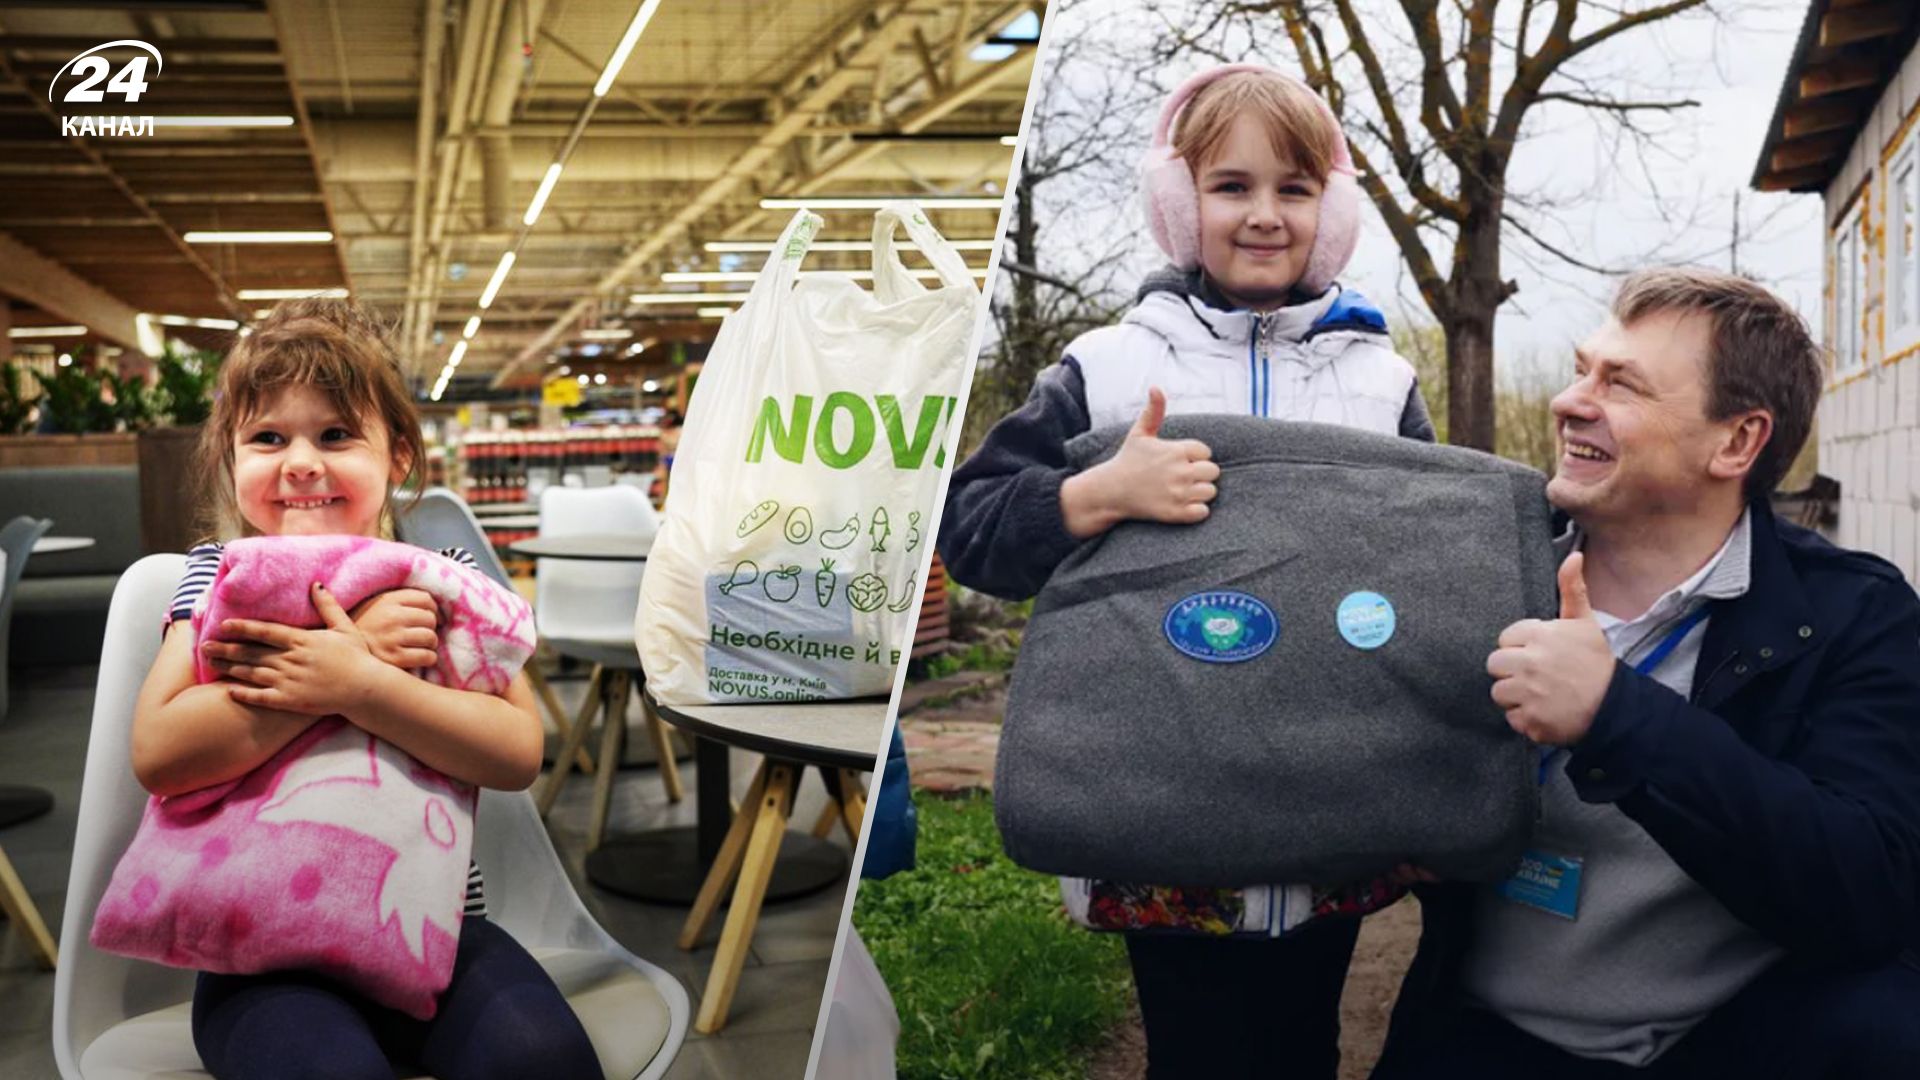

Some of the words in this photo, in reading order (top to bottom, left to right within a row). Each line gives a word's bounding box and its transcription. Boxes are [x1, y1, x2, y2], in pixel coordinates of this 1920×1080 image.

[711, 623, 855, 661] Необхідне
[865, 642, 879, 664] й
[709, 666, 768, 683] Доставка
[771, 675, 780, 686] у
